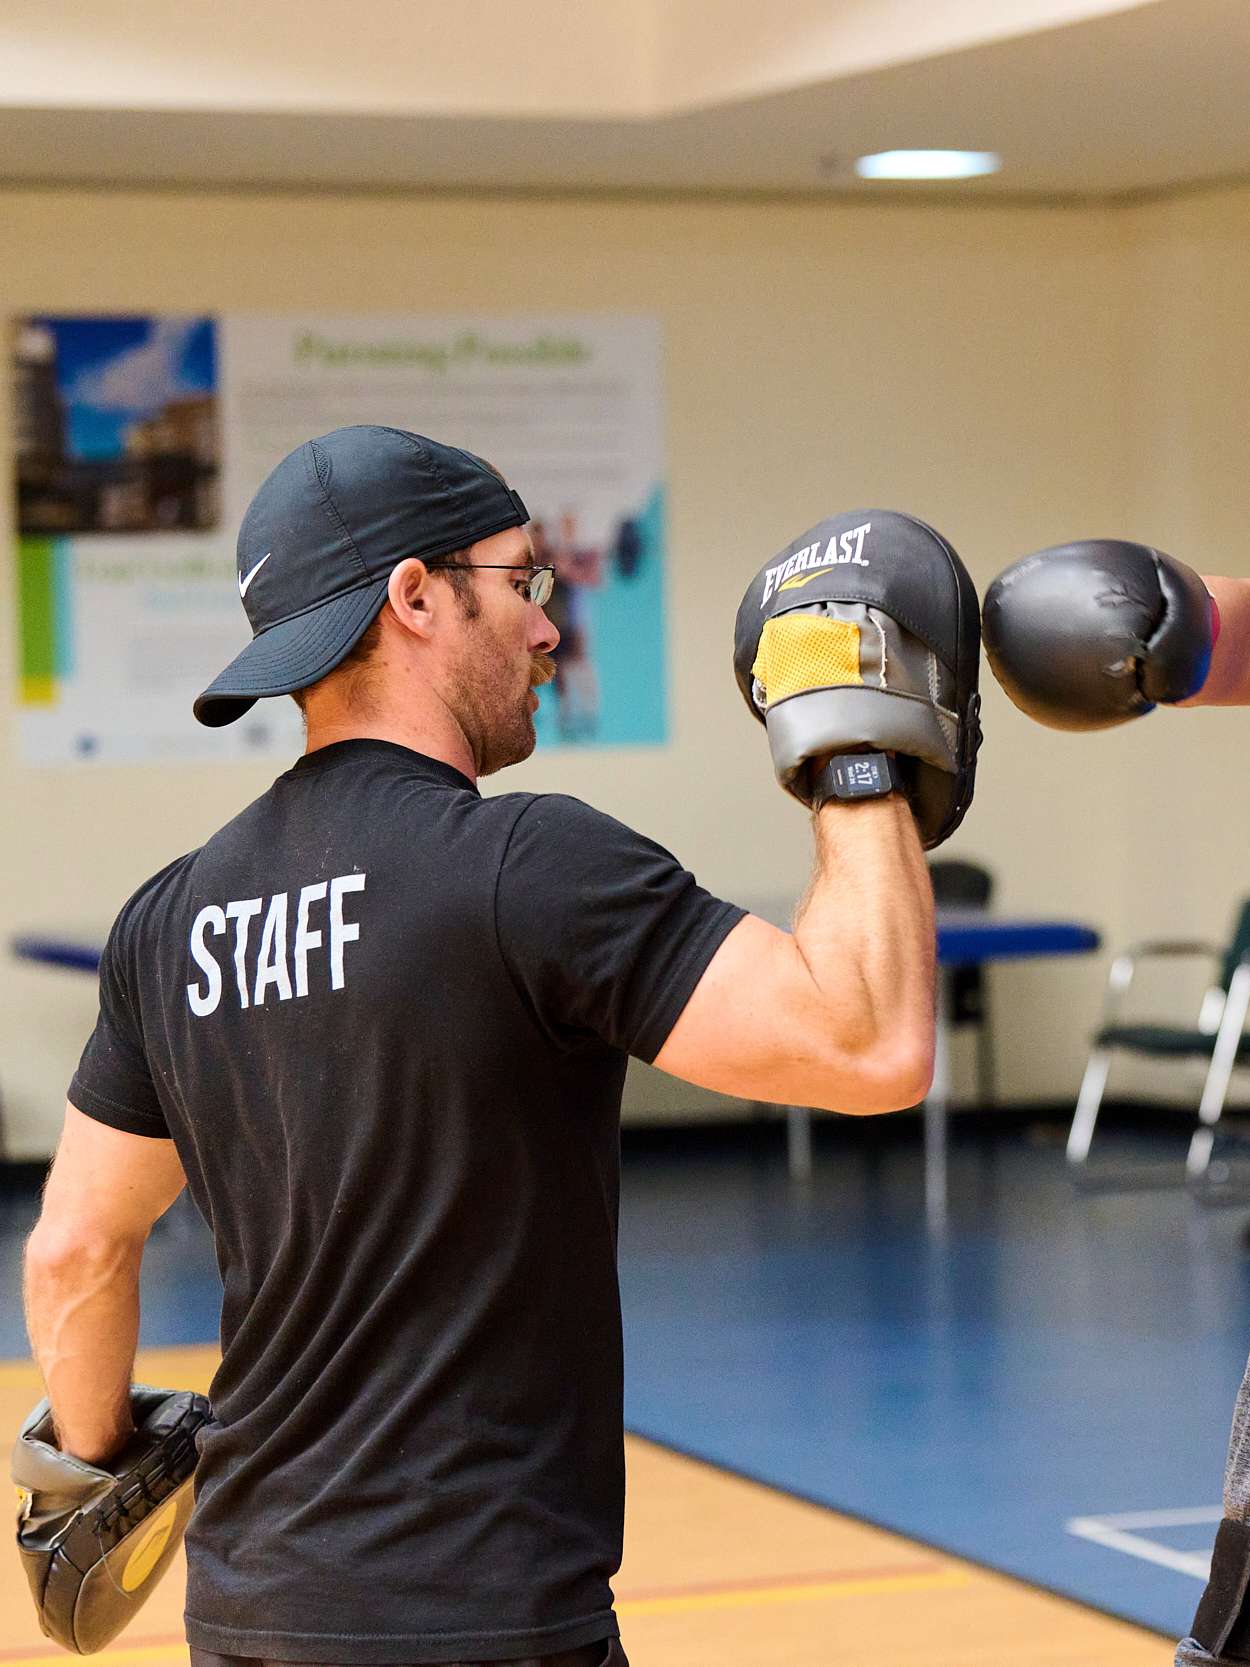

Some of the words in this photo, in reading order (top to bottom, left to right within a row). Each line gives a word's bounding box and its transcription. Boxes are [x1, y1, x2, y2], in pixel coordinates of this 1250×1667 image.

[760, 523, 871, 609] EVERLAST
[855, 762, 873, 785] 2:17
[187, 873, 366, 1017] STAFF
